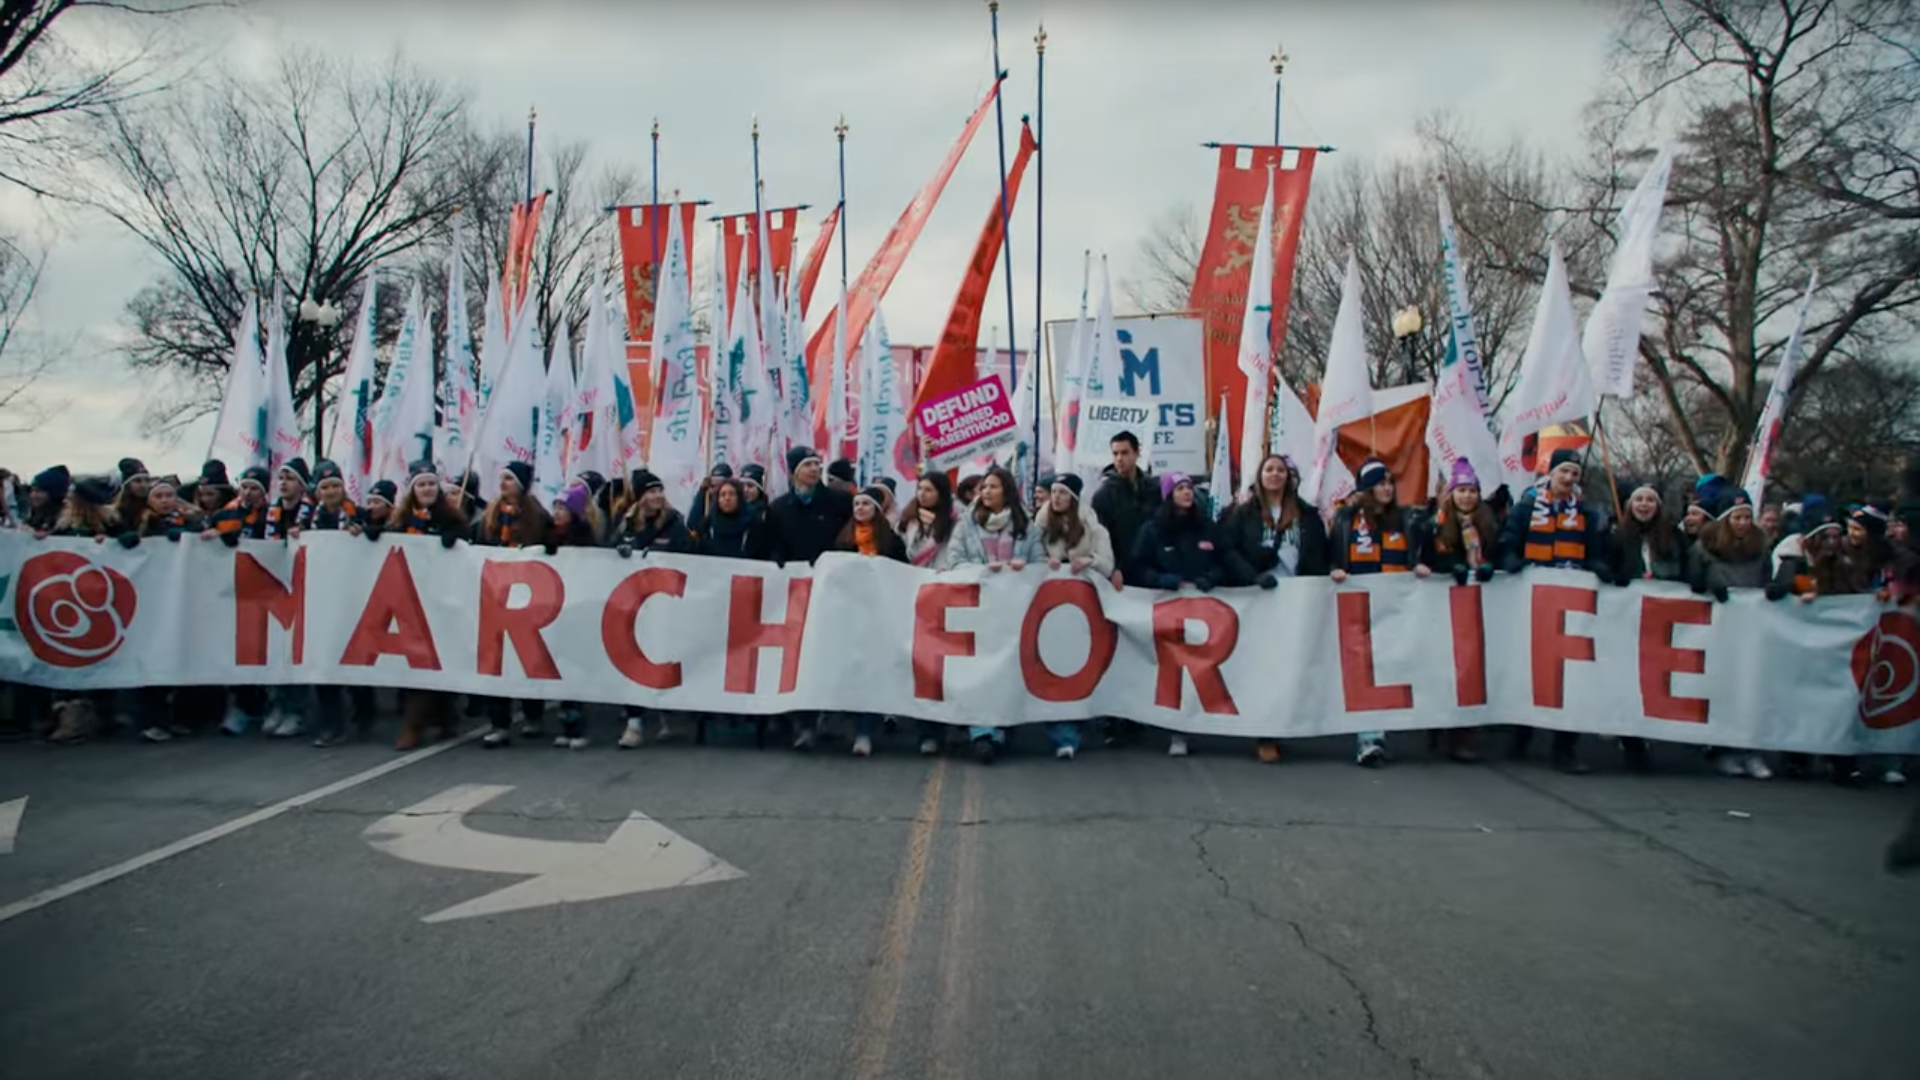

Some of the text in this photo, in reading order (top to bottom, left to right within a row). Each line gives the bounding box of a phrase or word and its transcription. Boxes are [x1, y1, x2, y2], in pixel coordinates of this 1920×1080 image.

[922, 382, 1000, 427] DEFUND
[938, 406, 994, 435] PLANNED
[1088, 404, 1149, 424] LIBERTY
[235, 546, 1712, 723] MARCH FOR LIFE
